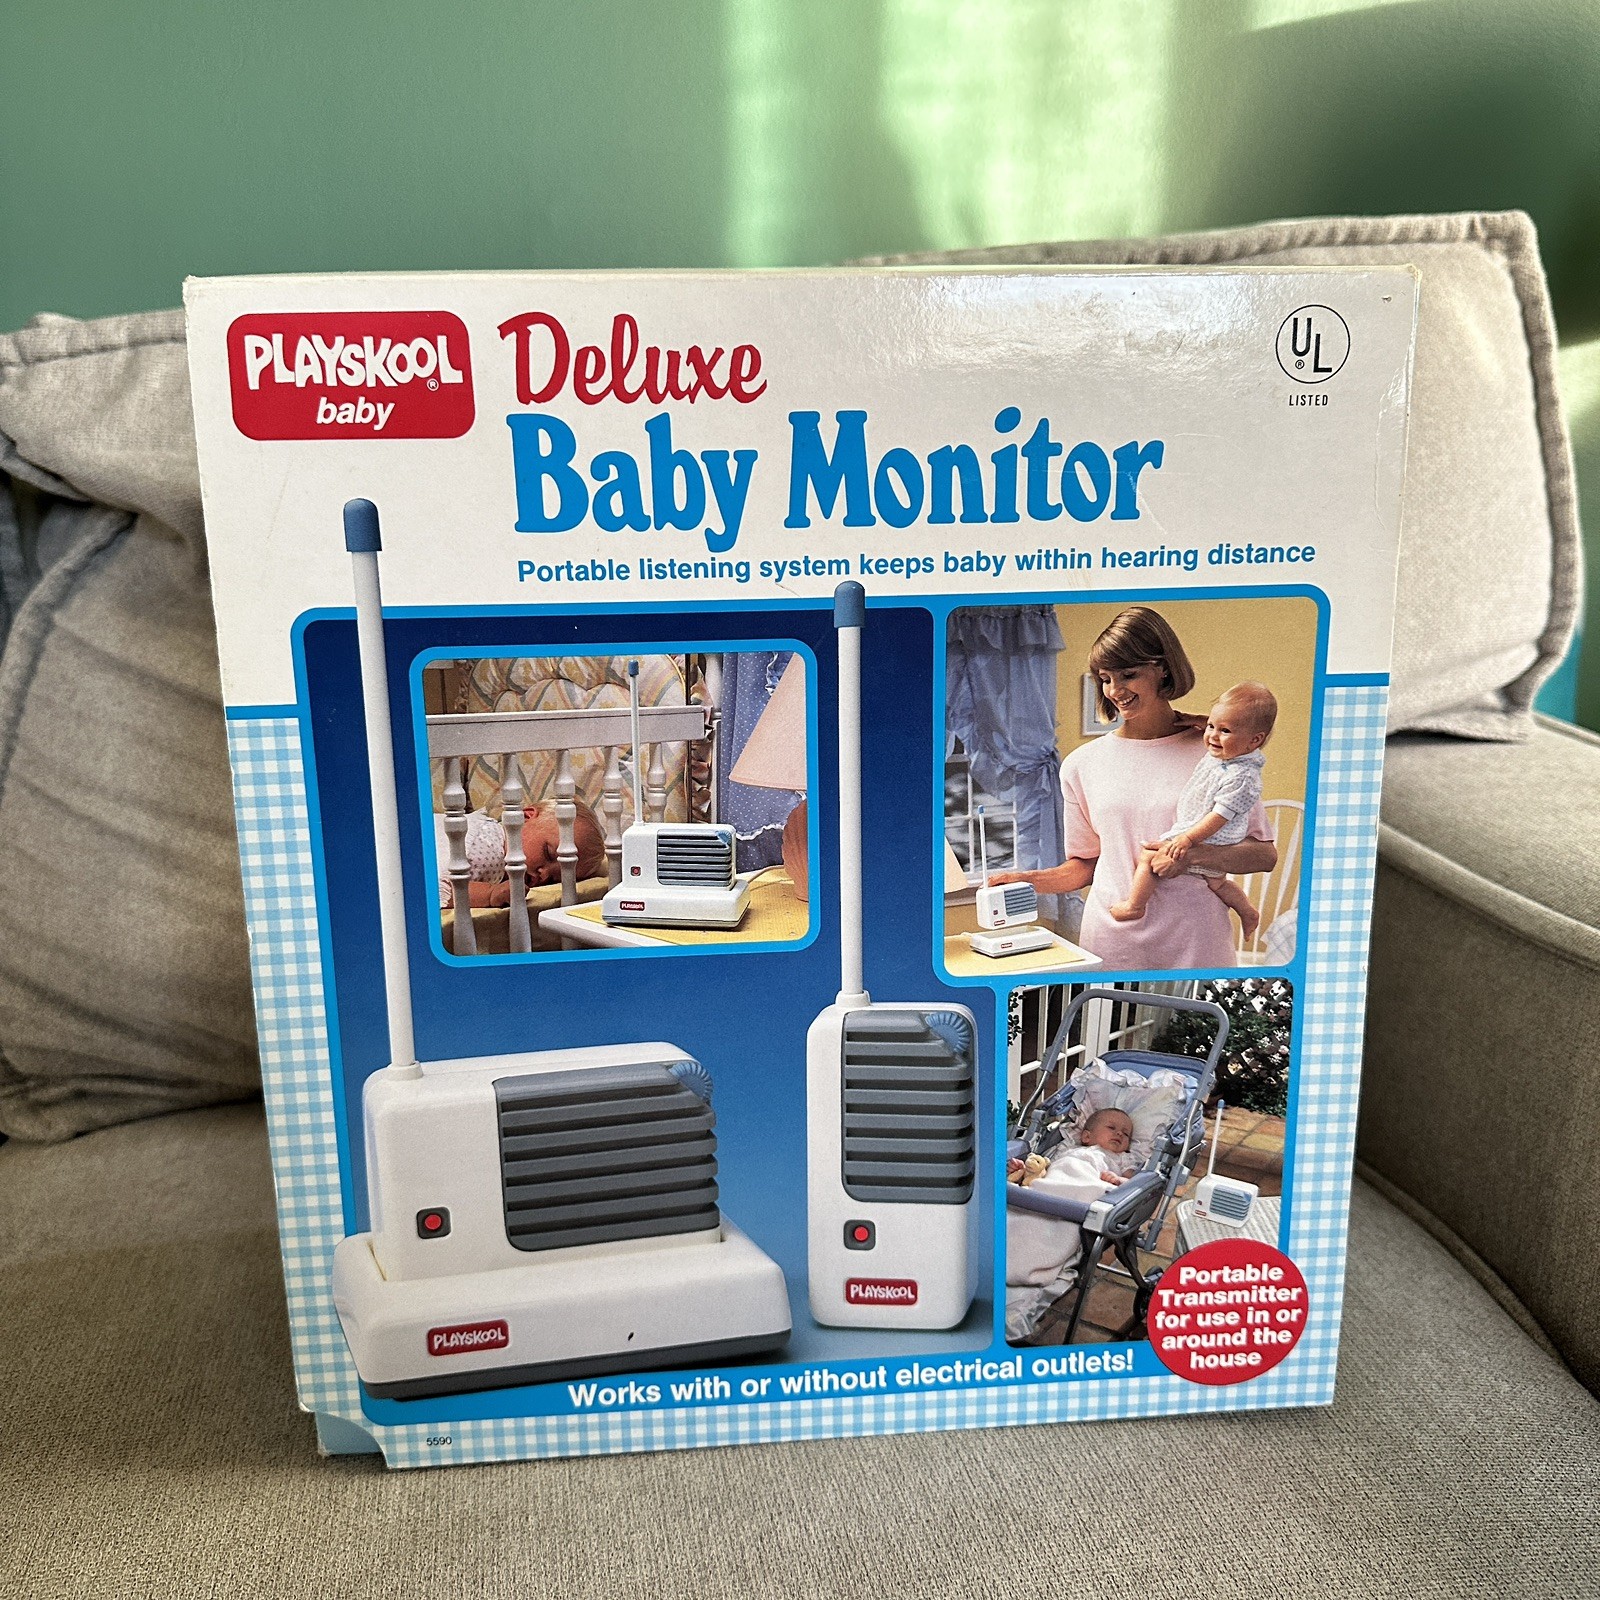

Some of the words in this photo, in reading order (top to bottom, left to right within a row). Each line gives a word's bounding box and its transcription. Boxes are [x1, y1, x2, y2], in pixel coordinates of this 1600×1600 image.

[1291, 317, 1333, 374] UL
[244, 333, 463, 390] PLAYSKOOL
[498, 311, 768, 405] Deluxe
[1288, 394, 1329, 406] LISTED
[316, 396, 394, 430] baby
[506, 412, 758, 553] Baby
[784, 406, 1165, 528] Monitor
[518, 559, 630, 583] Portable
[640, 556, 751, 584] listening
[758, 556, 850, 582] system
[860, 552, 935, 579] keeps
[943, 548, 1006, 577] baby
[1015, 546, 1092, 571] within
[1101, 543, 1198, 570] hearing
[1207, 541, 1316, 566] distance
[1179, 1264, 1284, 1286] Portable
[849, 1283, 915, 1301] PLAYSKOOL
[1158, 1284, 1301, 1308] Transmitter
[1155, 1310, 1190, 1329] for
[1197, 1312, 1240, 1327] use
[1247, 1307, 1268, 1324] in
[1276, 1307, 1302, 1323] or
[432, 1325, 506, 1350] PLAYSKOOL
[1162, 1327, 1247, 1350] around
[1253, 1327, 1292, 1345] the
[1190, 1350, 1262, 1370] house
[568, 1380, 661, 1409] Works
[671, 1375, 731, 1401] with
[740, 1377, 772, 1396] or
[779, 1366, 889, 1393] without
[895, 1359, 1023, 1387] electrical
[1031, 1349, 1135, 1377] outlets!
[426, 1436, 452, 1446] 5590
